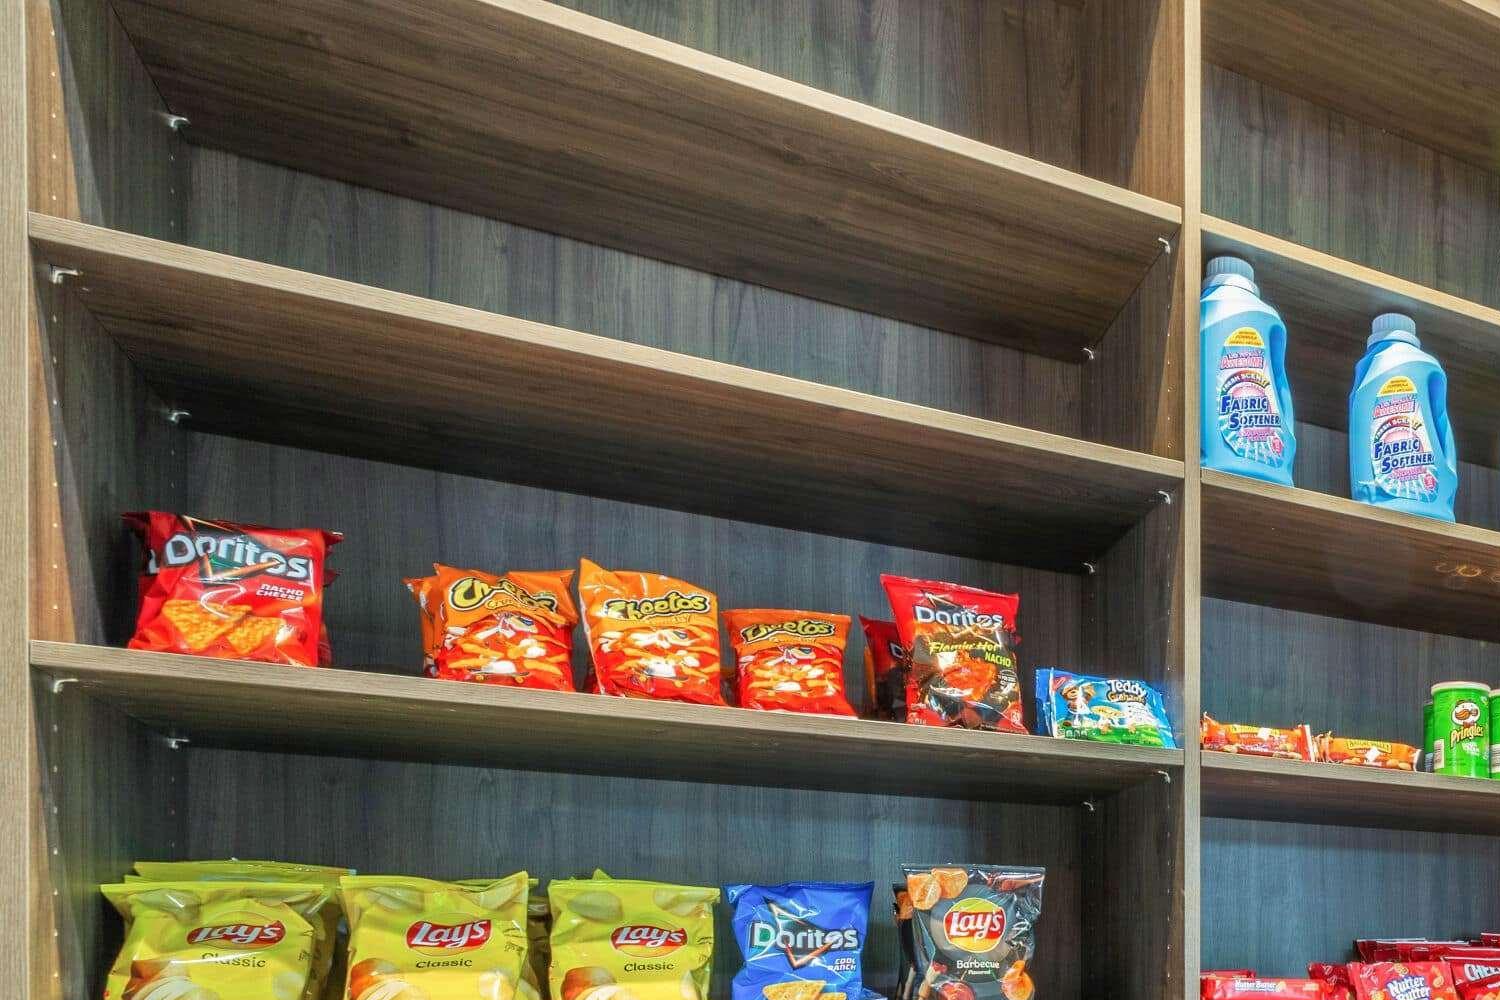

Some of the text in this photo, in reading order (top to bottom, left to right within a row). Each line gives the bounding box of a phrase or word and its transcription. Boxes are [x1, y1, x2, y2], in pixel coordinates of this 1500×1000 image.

[1221, 395, 1269, 414] FABRIC
[1229, 413, 1281, 430] SOFTENER
[1374, 438, 1420, 459] FABRIC
[1382, 453, 1435, 473] SOFTENER
[165, 534, 309, 578] Doritos
[256, 589, 305, 601] CHEESE
[261, 583, 305, 596] NACHO
[606, 593, 707, 619] Cheetos
[915, 606, 1003, 629] Doritos
[985, 652, 1012, 667] NACHO
[1108, 679, 1147, 697] Teddy
[1450, 726, 1484, 748] Pringles
[190, 922, 282, 944] Lay's
[949, 909, 1003, 939] Lay's
[411, 920, 486, 949] Lay's
[615, 926, 683, 949] Lay's
[752, 922, 858, 949] Doritos
[415, 959, 473, 969] Classic
[623, 962, 675, 972] Classic
[834, 957, 857, 965] COOL
[956, 959, 1000, 970] Barbecue
[1386, 977, 1425, 997] Nutter
